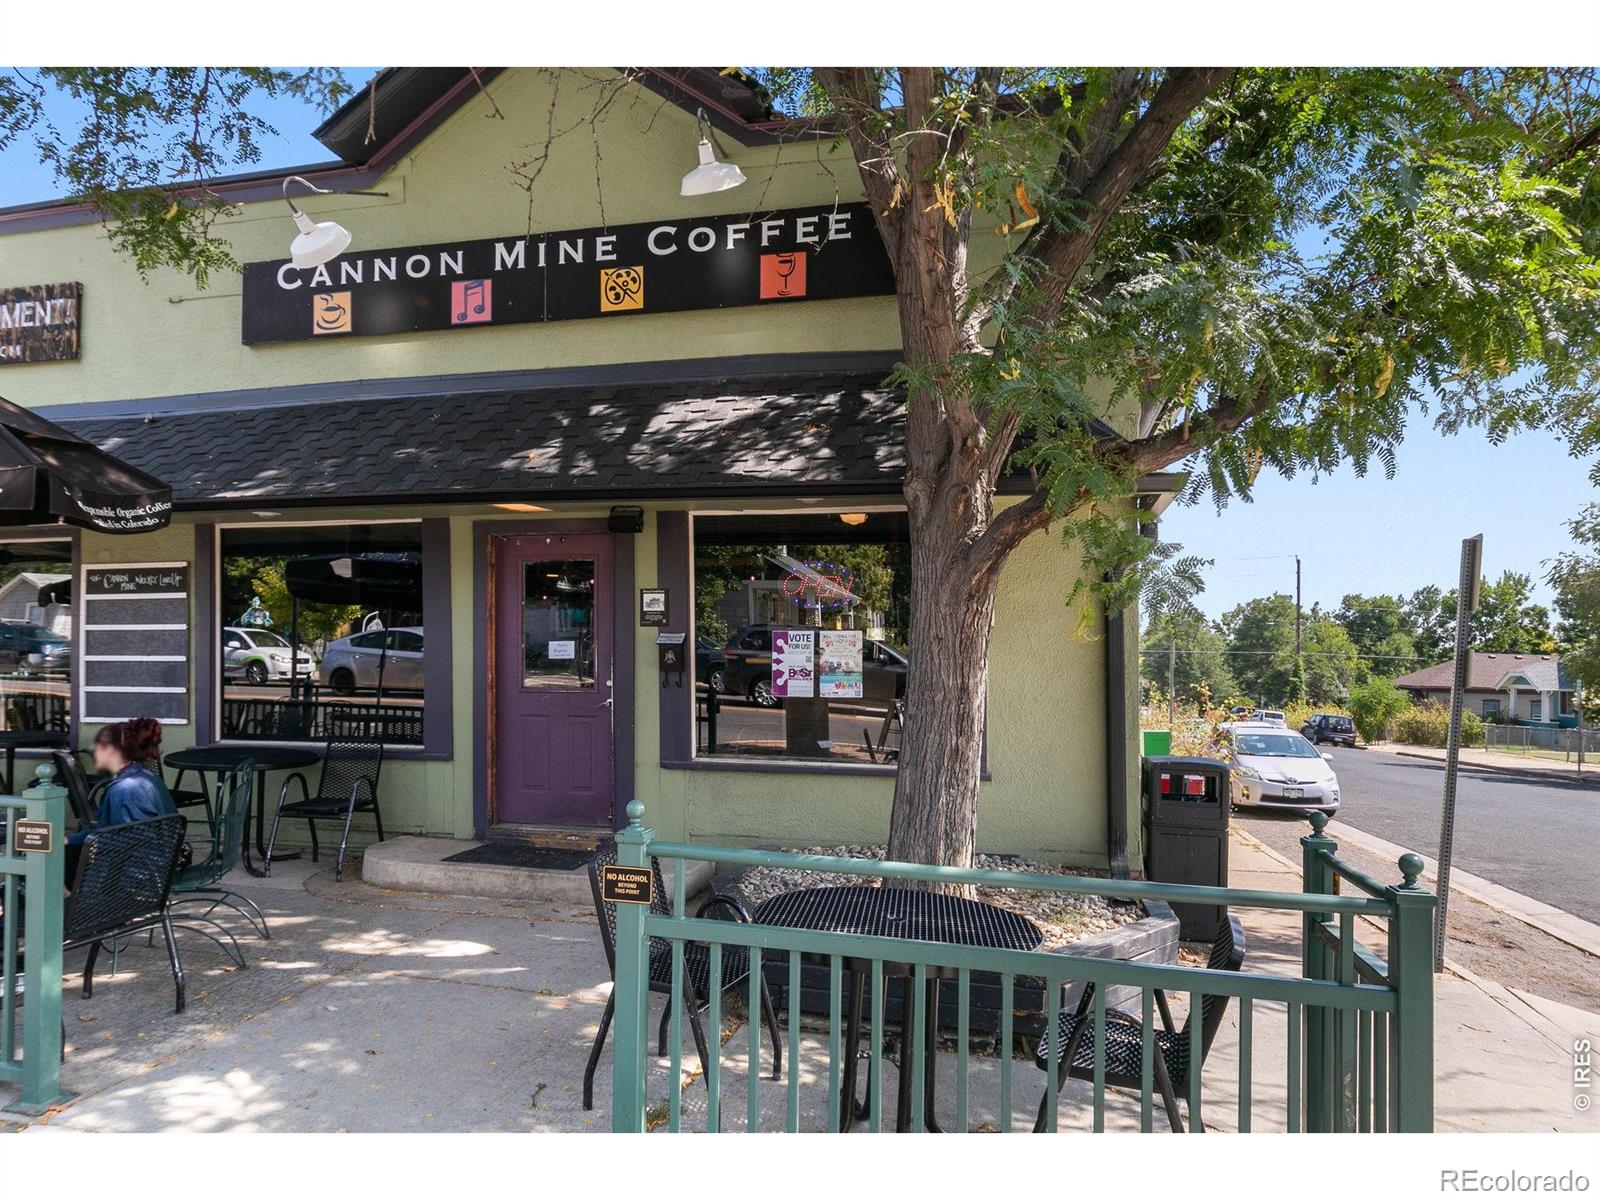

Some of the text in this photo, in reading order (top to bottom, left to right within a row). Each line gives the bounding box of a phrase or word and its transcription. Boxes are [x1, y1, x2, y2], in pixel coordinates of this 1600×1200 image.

[277, 212, 851, 290] CANNON MINE COFFEE
[116, 507, 146, 518] Organic
[121, 517, 159, 528] Colorado
[788, 633, 812, 643] VOTE
[617, 874, 649, 883] ALCOHOL
